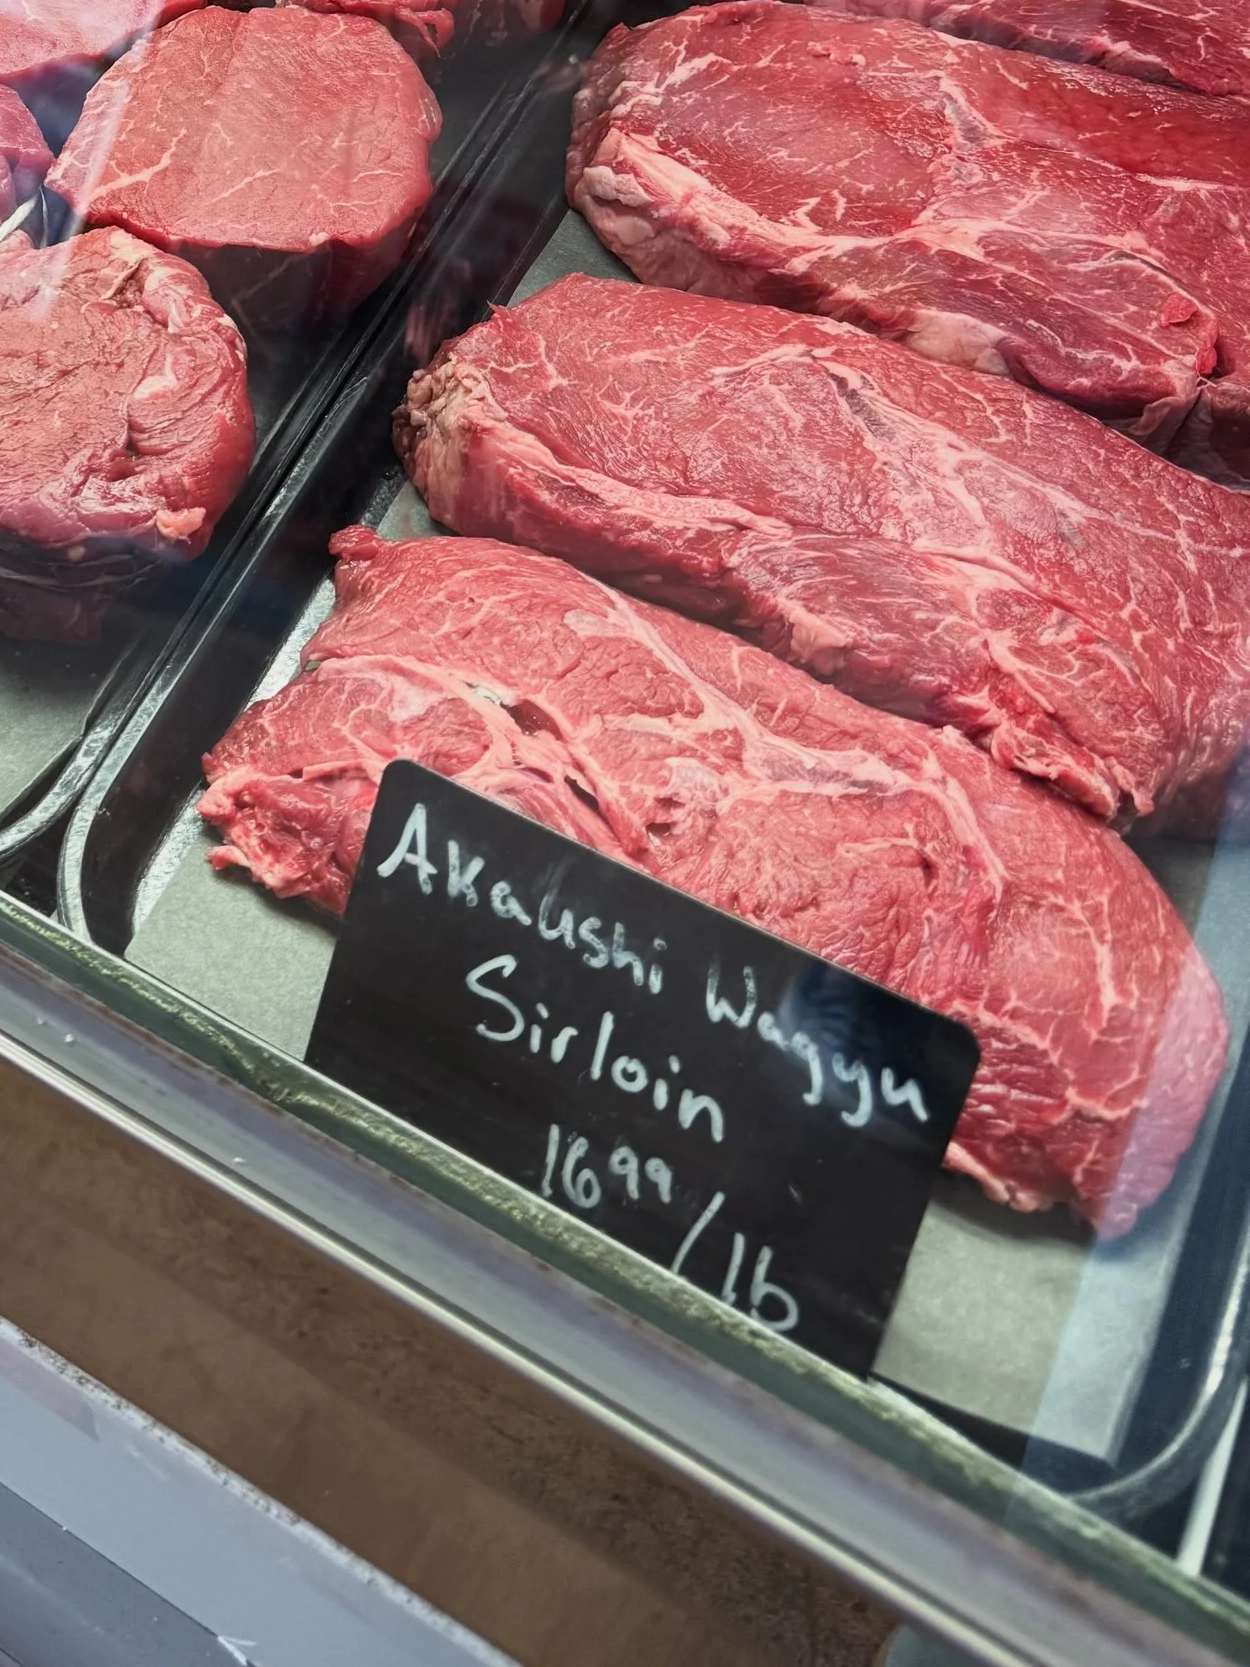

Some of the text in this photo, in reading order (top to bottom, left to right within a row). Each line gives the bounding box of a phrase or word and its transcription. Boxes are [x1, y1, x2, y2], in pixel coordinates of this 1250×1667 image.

[377, 802, 930, 1128] Akaushi Wagyu
[466, 954, 724, 1142] Sirloin
